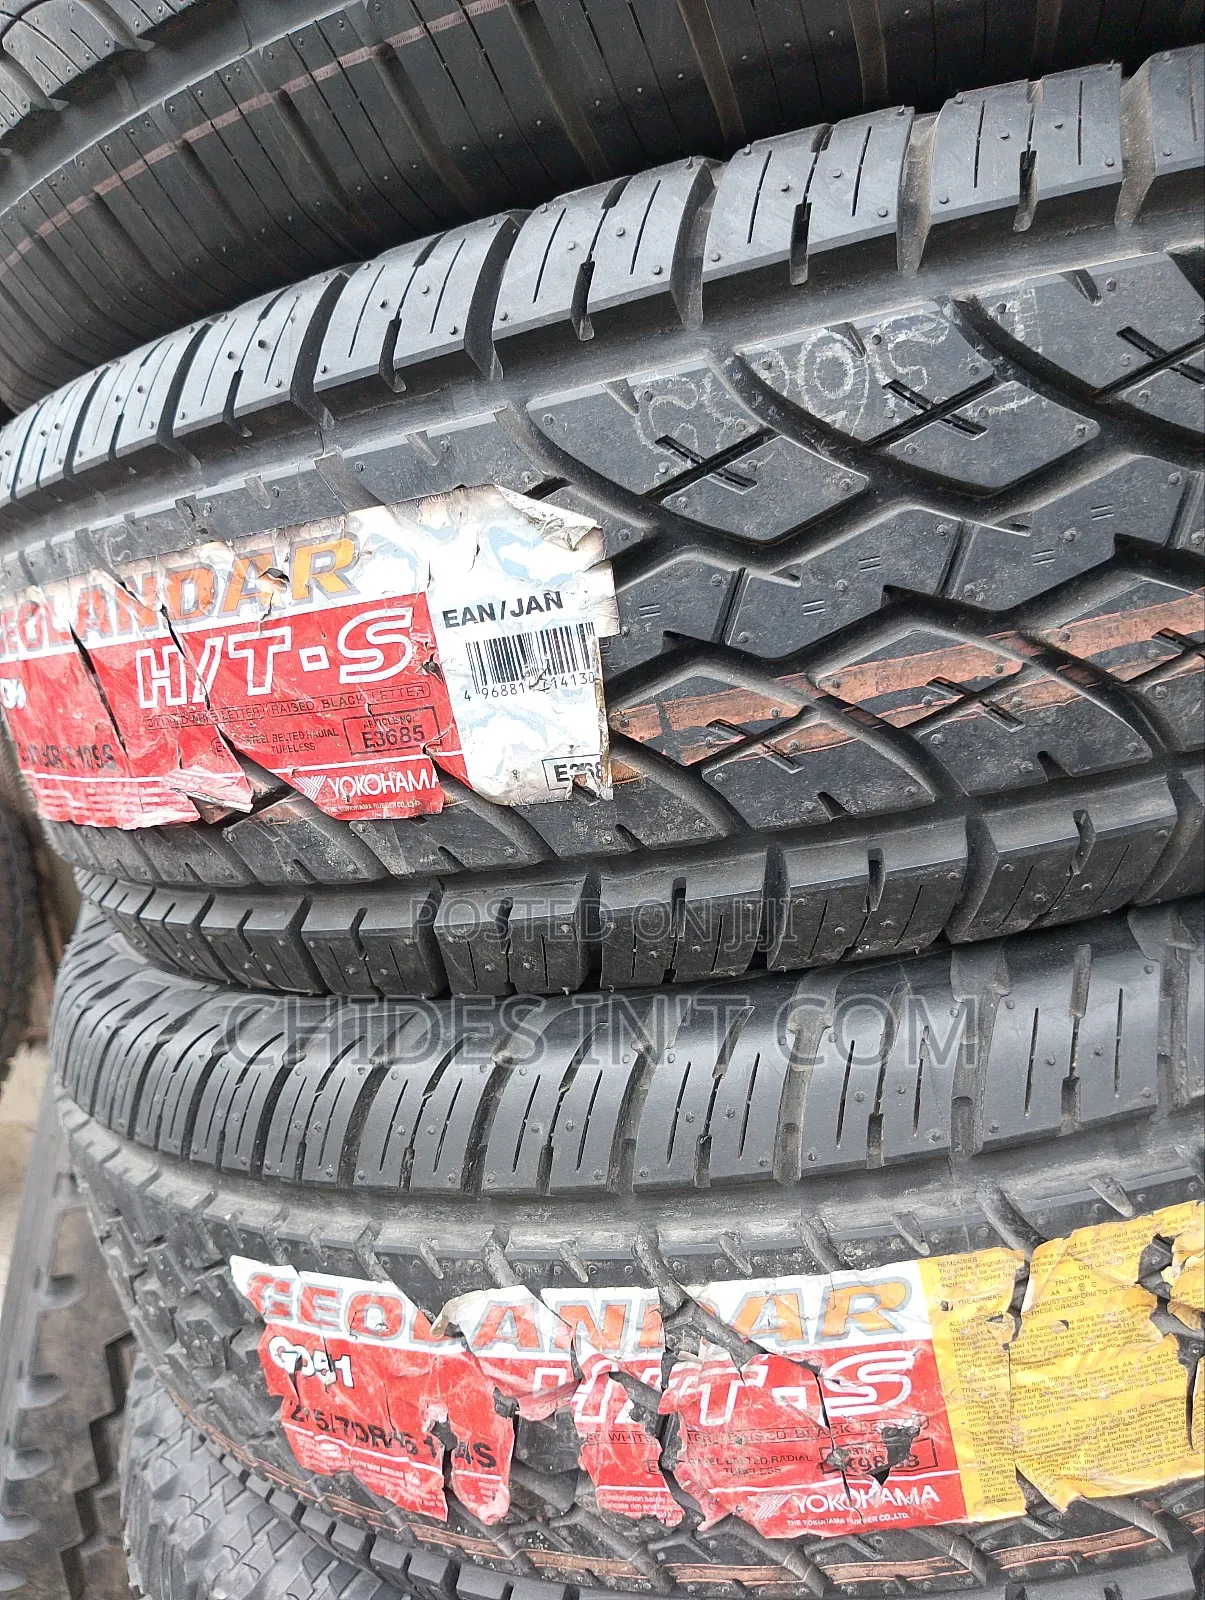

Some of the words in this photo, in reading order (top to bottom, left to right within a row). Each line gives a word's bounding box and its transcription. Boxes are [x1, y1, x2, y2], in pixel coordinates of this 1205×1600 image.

[0, 532, 362, 657] EOLANDAR
[442, 590, 564, 629] EAN/JAN
[135, 606, 415, 709] H/T-S
[221, 705, 262, 720] LETTER
[270, 700, 314, 713] RAISED
[321, 691, 363, 709] BLACK
[371, 686, 425, 702] LETTER
[272, 730, 304, 743] BELTED
[305, 727, 339, 740] RADIAL
[361, 724, 425, 750] E3685
[270, 742, 315, 755] TUBELESS
[1055, 1275, 1089, 1286] TRACTION
[795, 1422, 852, 1441] BLACK
[770, 1452, 813, 1465] RADIAL
[790, 1483, 941, 1514] YOKOHAMA
[786, 1518, 802, 1527] THE
